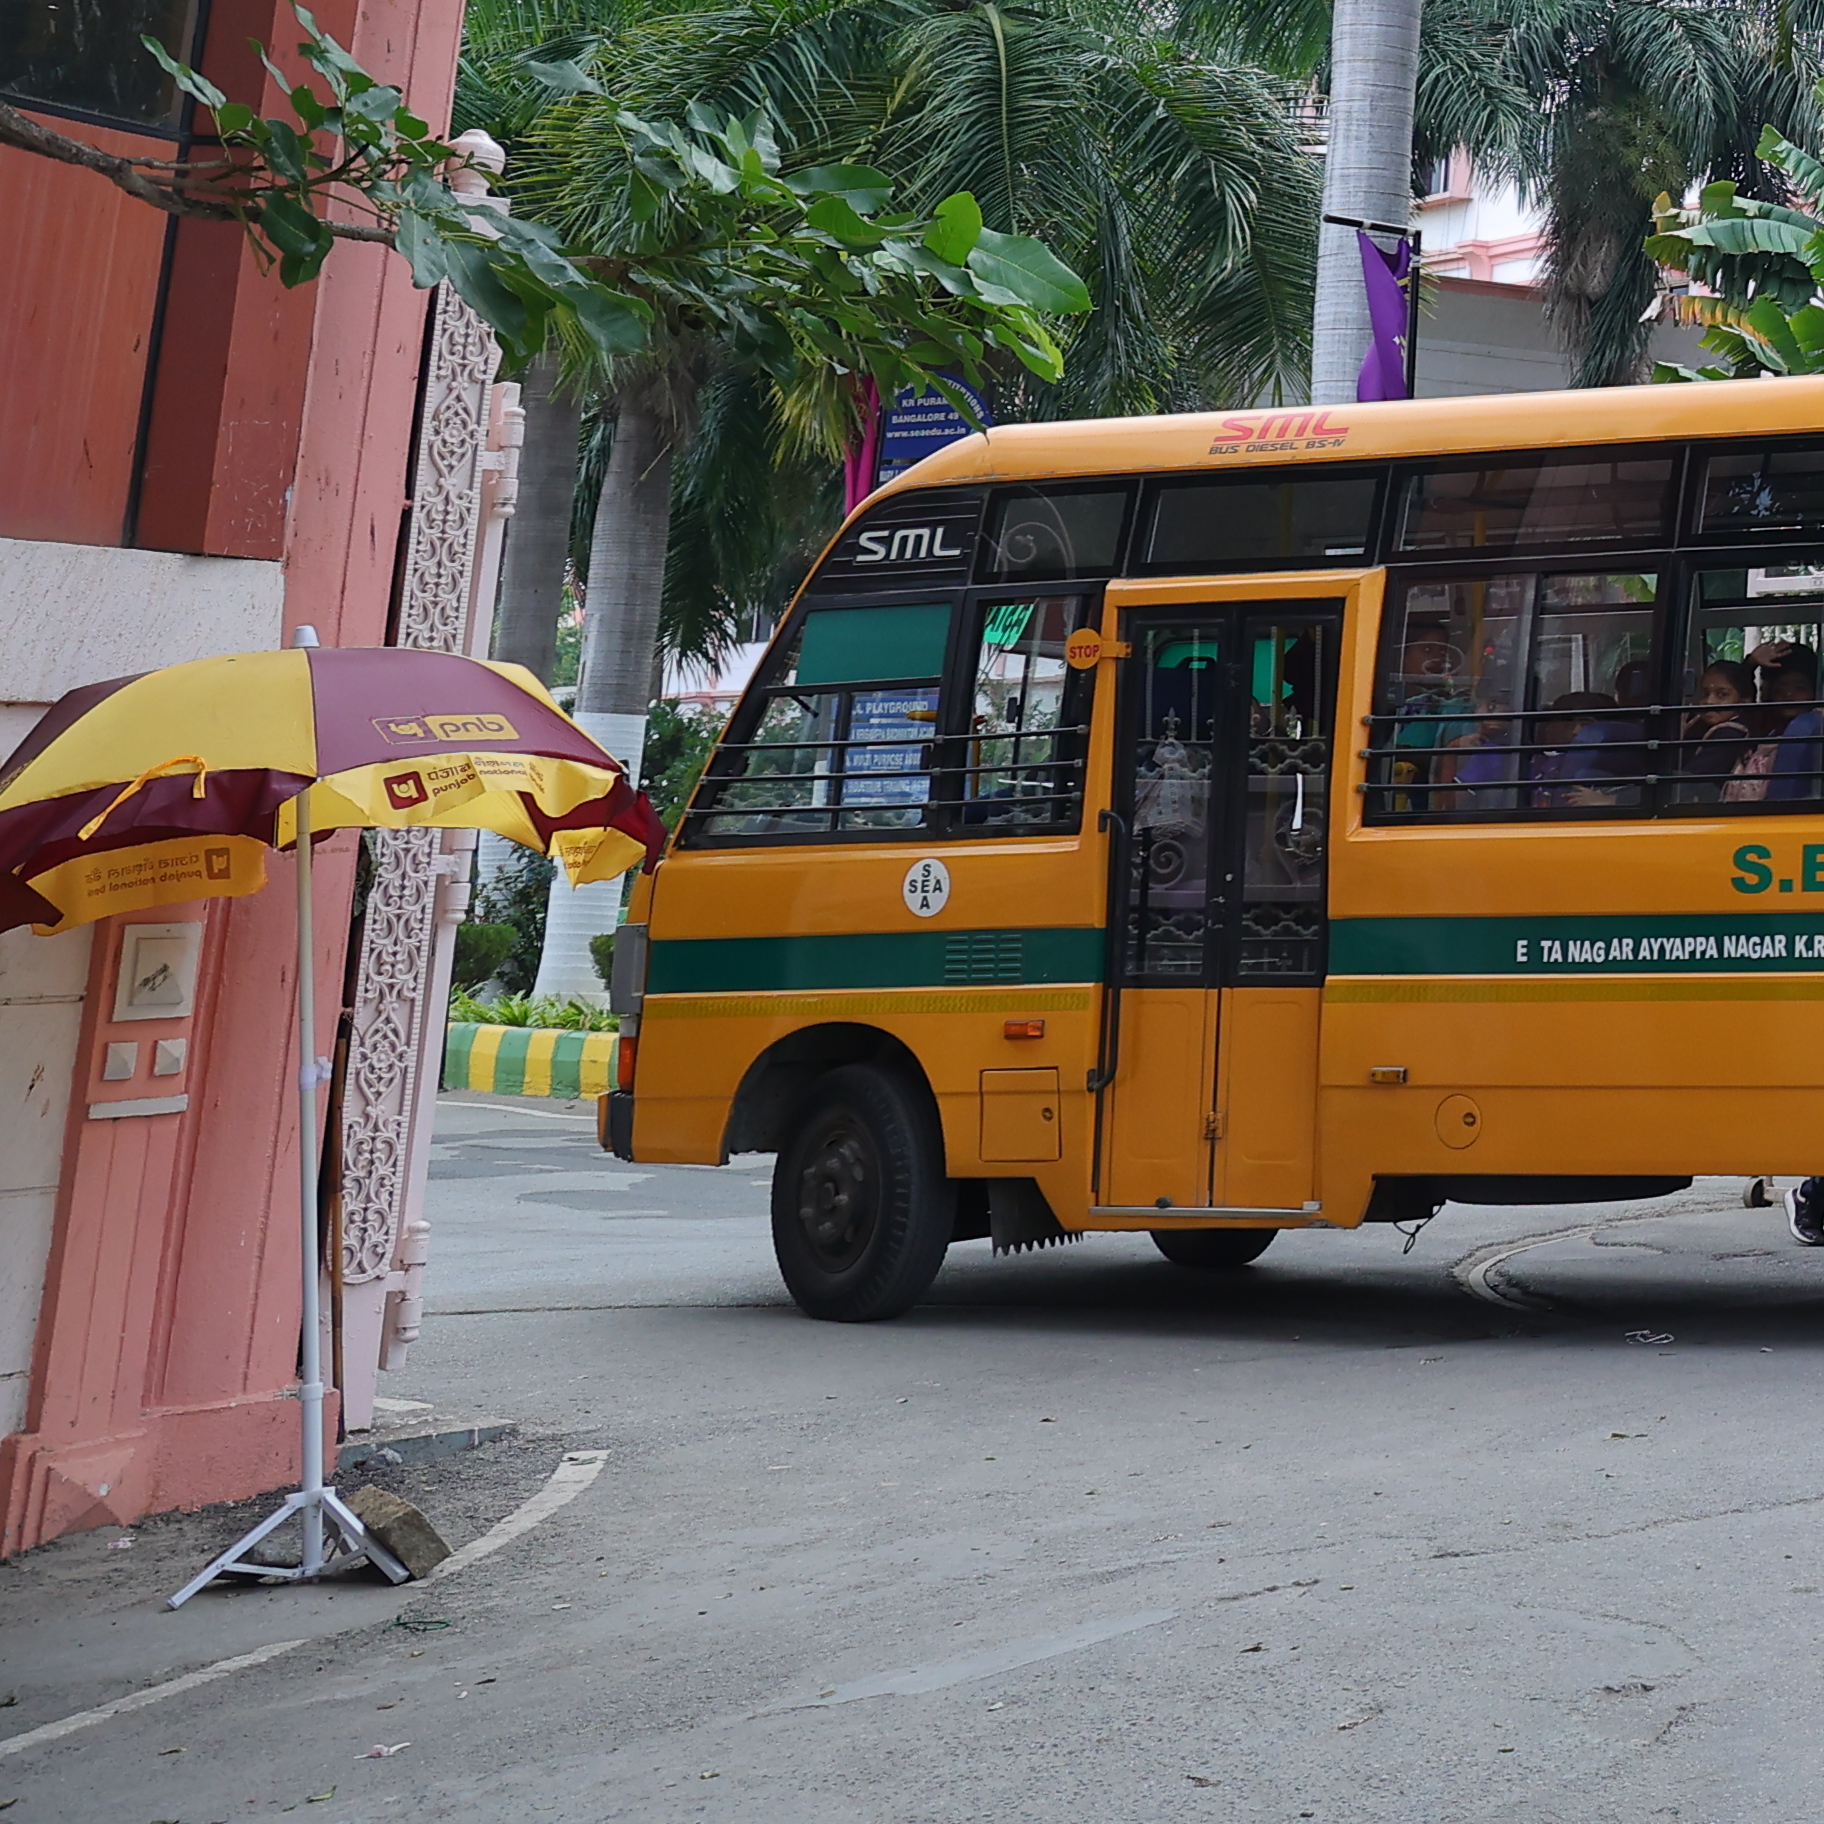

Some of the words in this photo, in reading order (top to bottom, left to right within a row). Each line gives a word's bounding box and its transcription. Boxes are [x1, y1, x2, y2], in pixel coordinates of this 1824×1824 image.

[892, 413, 946, 424] BANGALORE
[948, 412, 959, 420] 49
[1214, 411, 1350, 443] SML
[1208, 445, 1240, 455] BUS
[1246, 442, 1298, 453] DIESEL
[856, 526, 962, 562] SML
[1069, 644, 1100, 660] STOP
[438, 717, 505, 738] pnb
[432, 772, 476, 798] punjab
[1637, 936, 1719, 961] AYYAPPA
[1723, 934, 1787, 959] NAGAR
